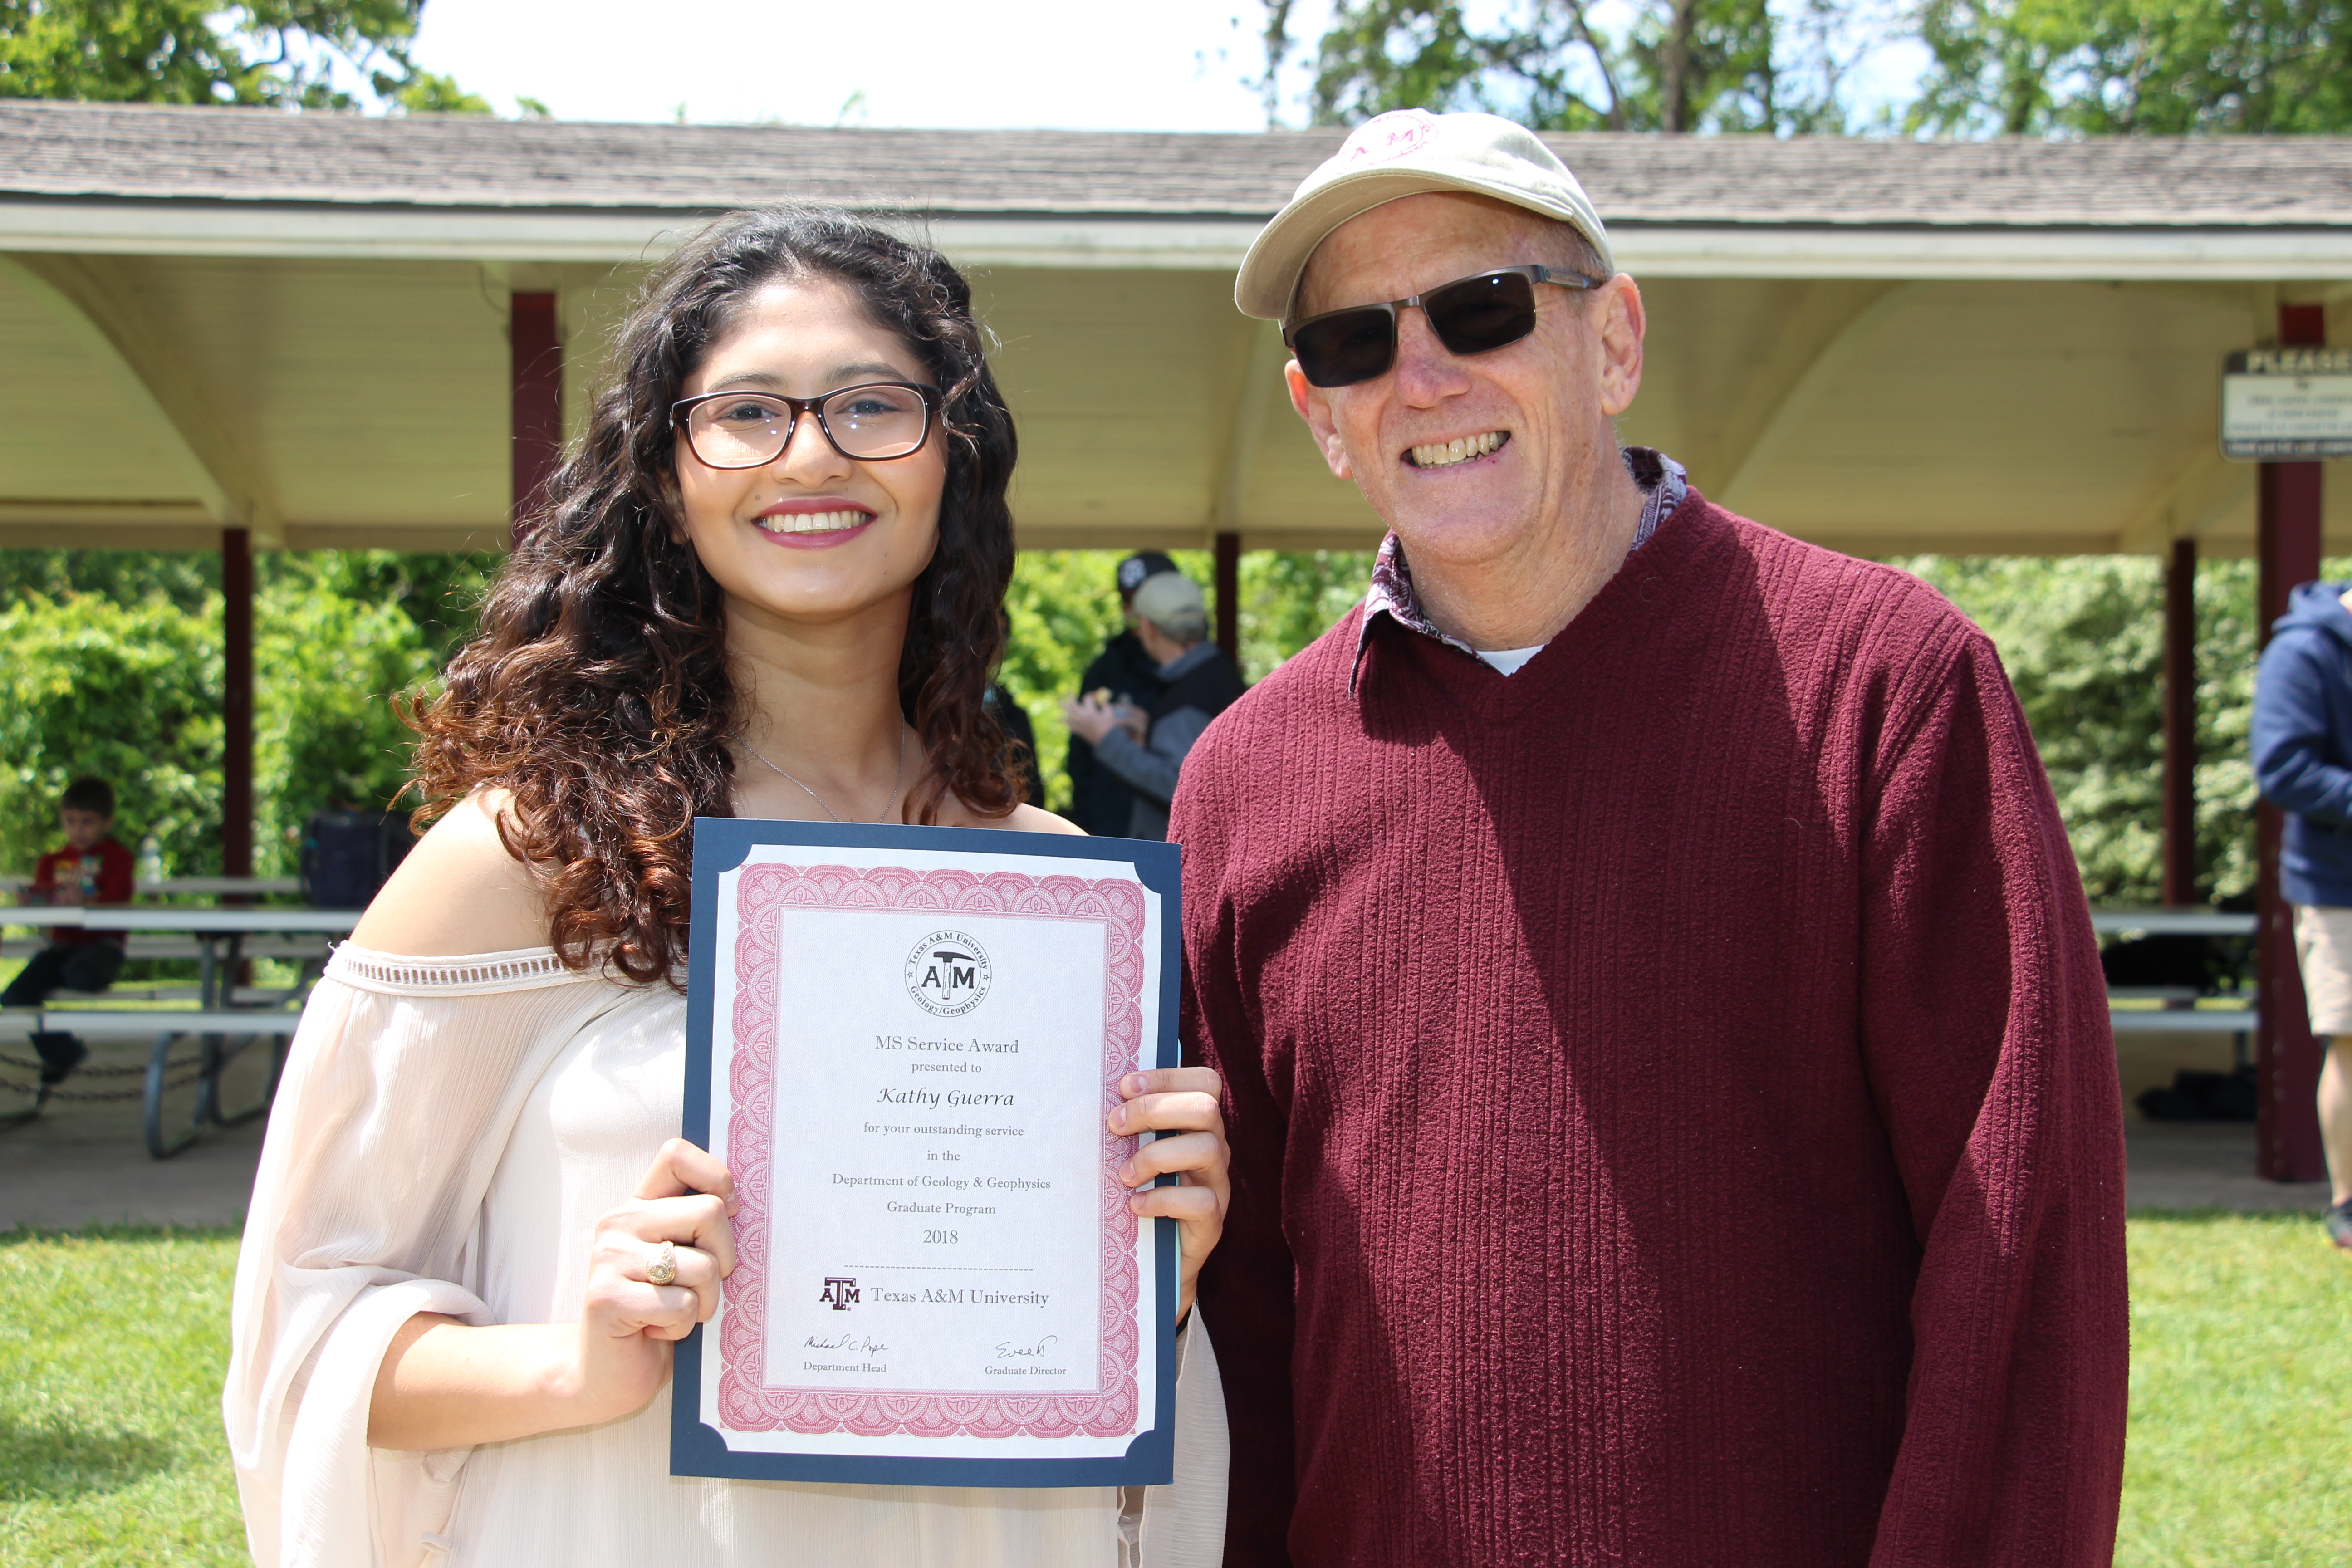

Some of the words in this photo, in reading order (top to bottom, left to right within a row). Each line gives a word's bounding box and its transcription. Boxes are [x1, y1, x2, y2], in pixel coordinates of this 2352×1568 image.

[2247, 348, 2352, 372] PLEASE
[908, 942, 927, 965] Texas
[929, 932, 953, 945] A&M
[956, 933, 988, 970] University
[910, 985, 986, 1015] Geology/Geophysics
[875, 1035, 902, 1049] MS
[907, 1037, 964, 1052] Service
[968, 1038, 1019, 1053] Award
[911, 1062, 967, 1074] presented
[971, 1064, 982, 1073] to
[877, 1087, 941, 1110] Kathy
[947, 1090, 1014, 1108] Guerra
[863, 1122, 880, 1132] for
[883, 1126, 911, 1136] your
[913, 1124, 983, 1138] outstanding
[985, 1125, 1024, 1136] service
[927, 1150, 938, 1161] in
[942, 1150, 960, 1161] the
[832, 1173, 903, 1188] Department
[907, 1175, 920, 1186] of
[921, 1176, 970, 1191] Geology
[973, 1176, 983, 1188] &
[986, 1177, 1051, 1191] Geophysics
[887, 1201, 941, 1213] Graduate
[945, 1202, 996, 1217] Program
[923, 1229, 958, 1244] 2018
[870, 1287, 916, 1303] Texas
[921, 1289, 964, 1303] A&M
[970, 1289, 1049, 1308] University
[803, 1361, 859, 1373] Department
[862, 1363, 887, 1372] Head
[985, 1366, 1027, 1375] Graduate
[1029, 1366, 1067, 1375] Director
